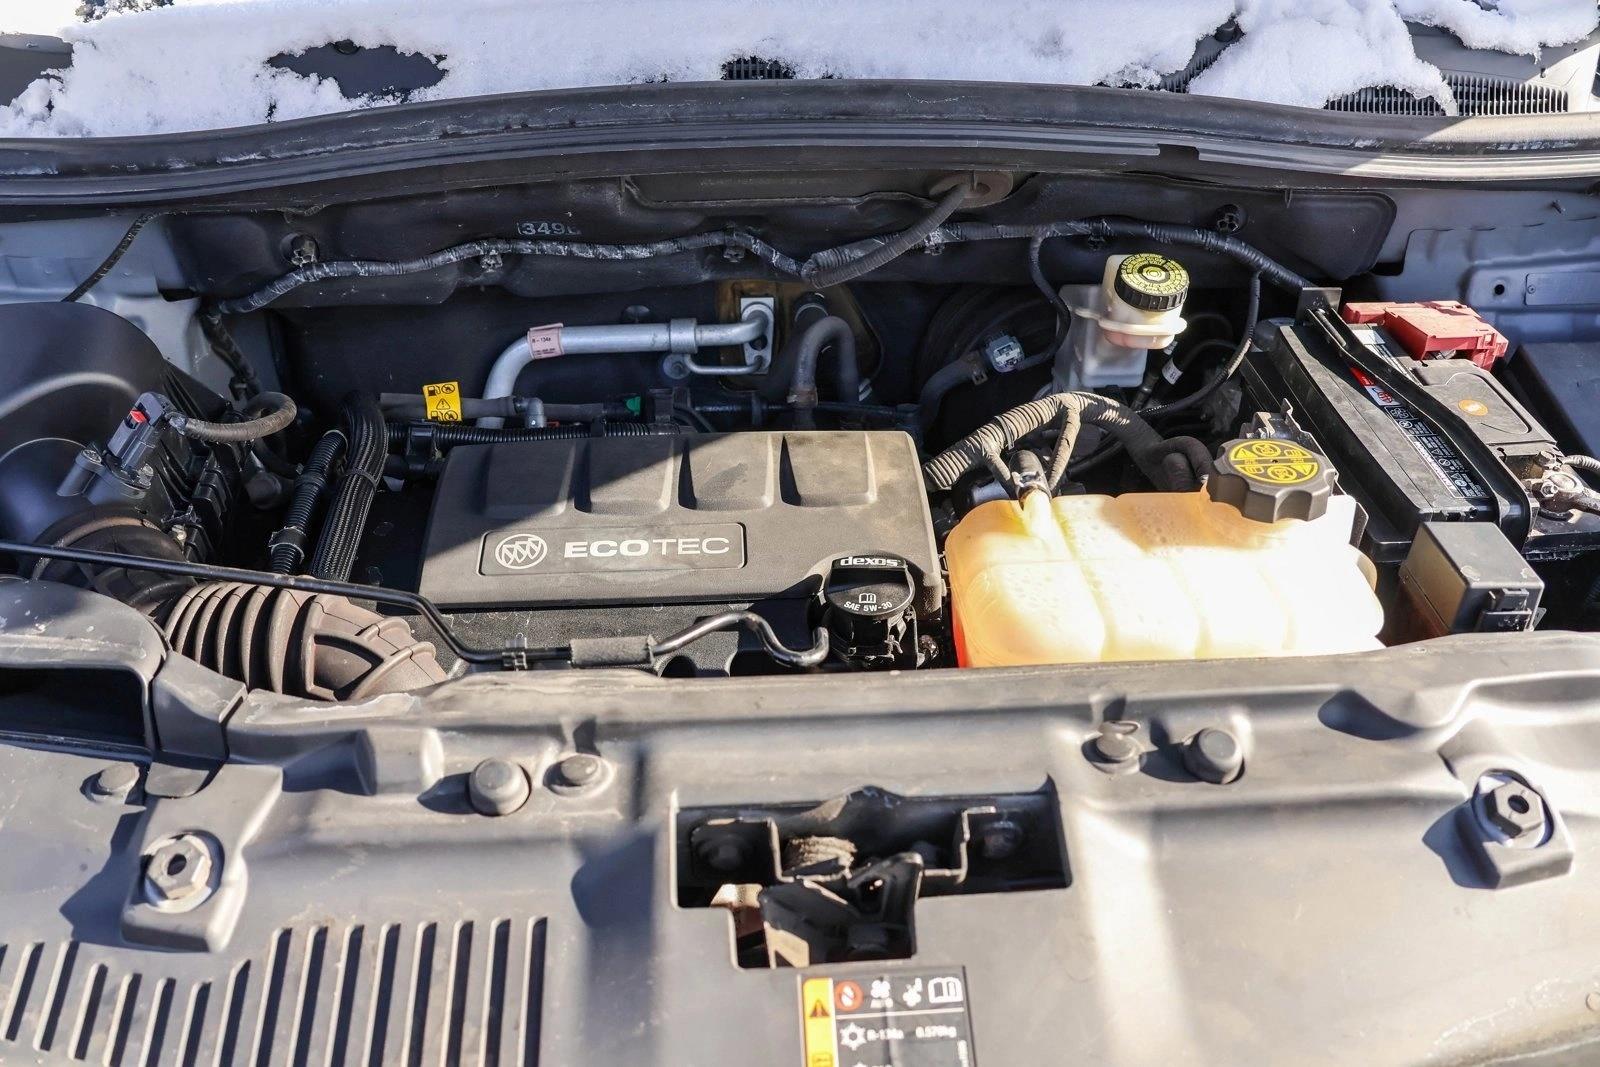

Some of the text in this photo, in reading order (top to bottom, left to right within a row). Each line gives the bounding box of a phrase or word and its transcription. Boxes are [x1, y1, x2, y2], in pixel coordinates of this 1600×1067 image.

[564, 537, 730, 558] ECOTEC
[840, 556, 898, 566] dexos
[844, 601, 892, 612] SAE 5W-30
